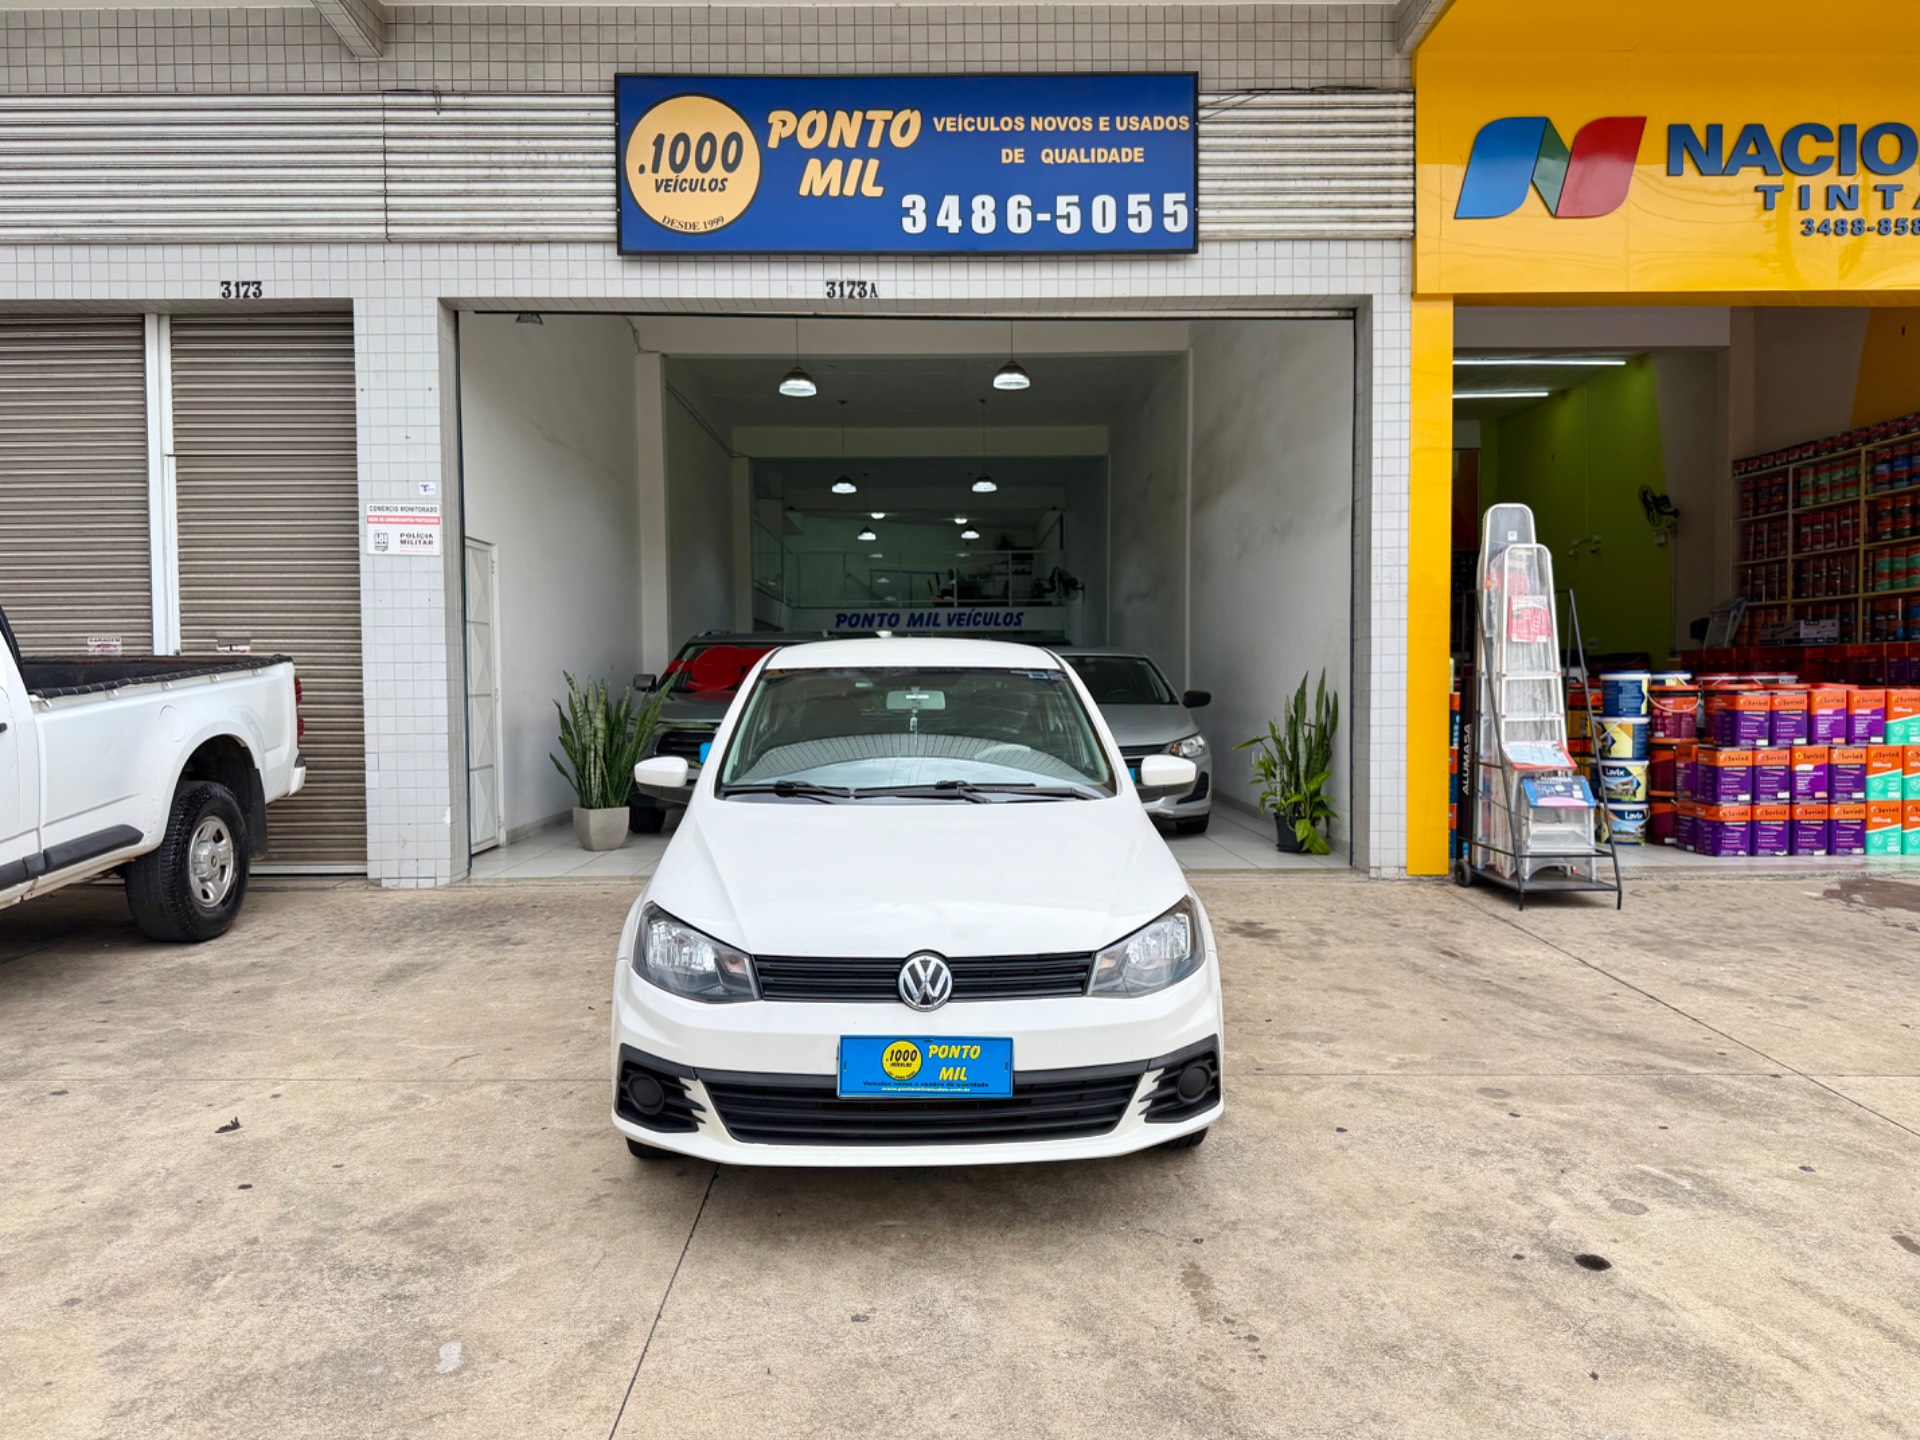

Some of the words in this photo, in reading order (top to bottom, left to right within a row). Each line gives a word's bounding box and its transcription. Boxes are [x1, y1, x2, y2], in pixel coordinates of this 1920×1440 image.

[766, 107, 923, 151] PONTO
[933, 114, 1025, 132] VEÍCULOS
[1030, 116, 1093, 132] NOVOS
[1099, 116, 1110, 131] E
[1115, 115, 1190, 131] USADOS
[638, 131, 744, 175] .1000
[1001, 148, 1025, 164] DE
[1041, 147, 1145, 164] QUALIDADE
[654, 174, 728, 193] VEÍCULOS
[798, 157, 886, 198] MIL
[662, 215, 700, 231] DESDE
[703, 215, 725, 229] 1999
[900, 192, 1189, 235] 3486-5055
[221, 281, 263, 299] 3173
[826, 280, 879, 299] 3173A
[835, 612, 901, 628] PONTO
[906, 612, 942, 628] MIL
[946, 608, 1024, 628] VEÍCULOS
[1463, 723, 1472, 796] ALUMASA
[886, 1049, 918, 1062] .1000
[928, 1044, 981, 1060] PONTO
[939, 1066, 968, 1081] MIL
